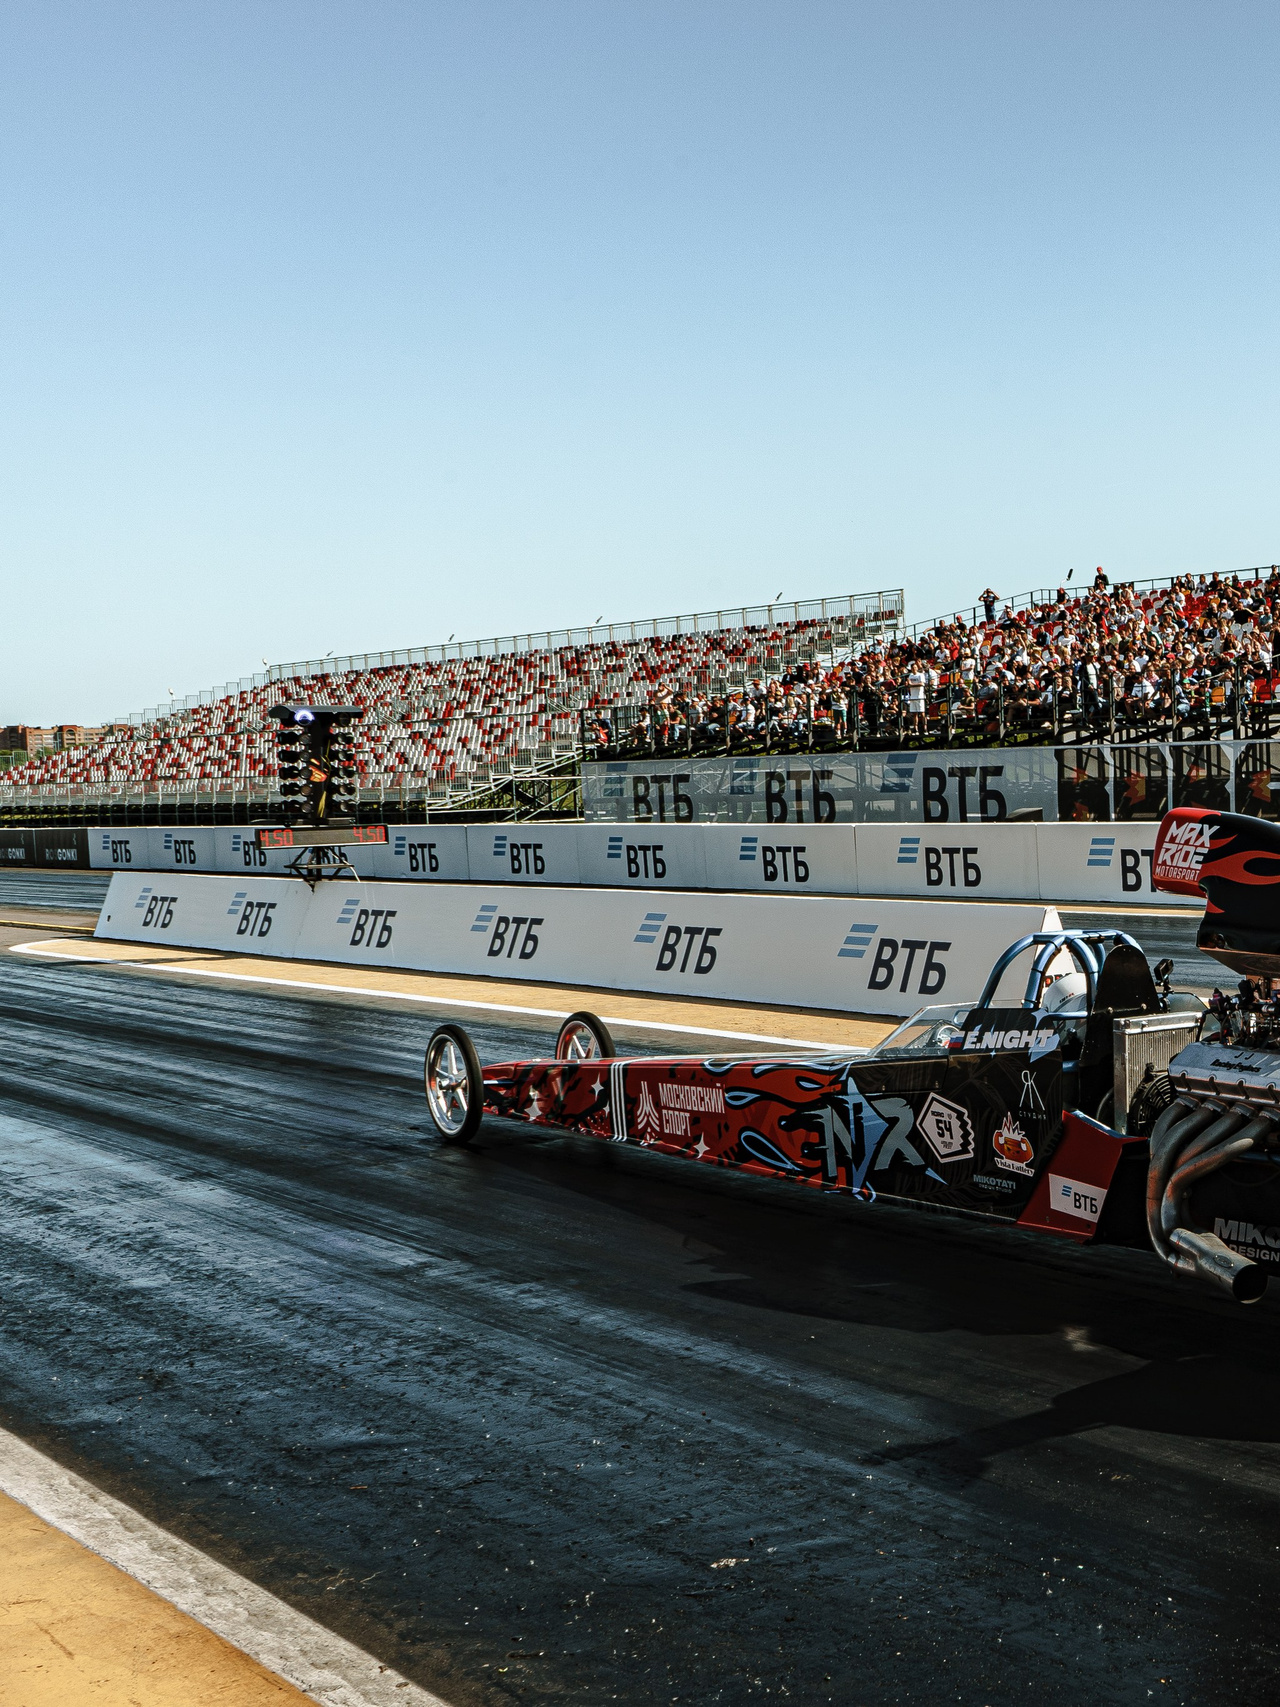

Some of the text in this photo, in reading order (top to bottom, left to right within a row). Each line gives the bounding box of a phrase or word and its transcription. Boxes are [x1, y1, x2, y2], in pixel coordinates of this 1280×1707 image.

[633, 774, 694, 823] ВТБ
[766, 770, 836, 823] ВТБ
[922, 766, 1007, 823] ВТБ
[1165, 820, 1220, 848] MAX
[111, 840, 132, 863] ВТБ
[174, 840, 197, 864] ВТБ
[409, 843, 439, 872] ВТБ
[509, 843, 545, 874] ВТБ
[626, 845, 667, 878] ВТБ
[762, 846, 810, 882] ВТБ
[925, 847, 982, 887] ВТБ
[1158, 842, 1209, 870] RIDE
[1120, 849, 1156, 892] ВТ
[1155, 865, 1200, 881] MOTORSPORT
[142, 896, 178, 928] ВТБ
[236, 901, 277, 937] ВТБ
[349, 909, 397, 948] ВТБ
[487, 916, 544, 960] ВТБ
[655, 925, 723, 974] ВТБ
[867, 937, 952, 995] ВТБ
[964, 1030, 1054, 1049] E.NIGHT
[659, 1082, 725, 1114] МОСКОВСКИЙ
[662, 1109, 691, 1136] СПОРТ
[935, 1118, 953, 1140] 54
[973, 1174, 1016, 1189] MIKOTATI
[1073, 1191, 1098, 1214] ВТБ
